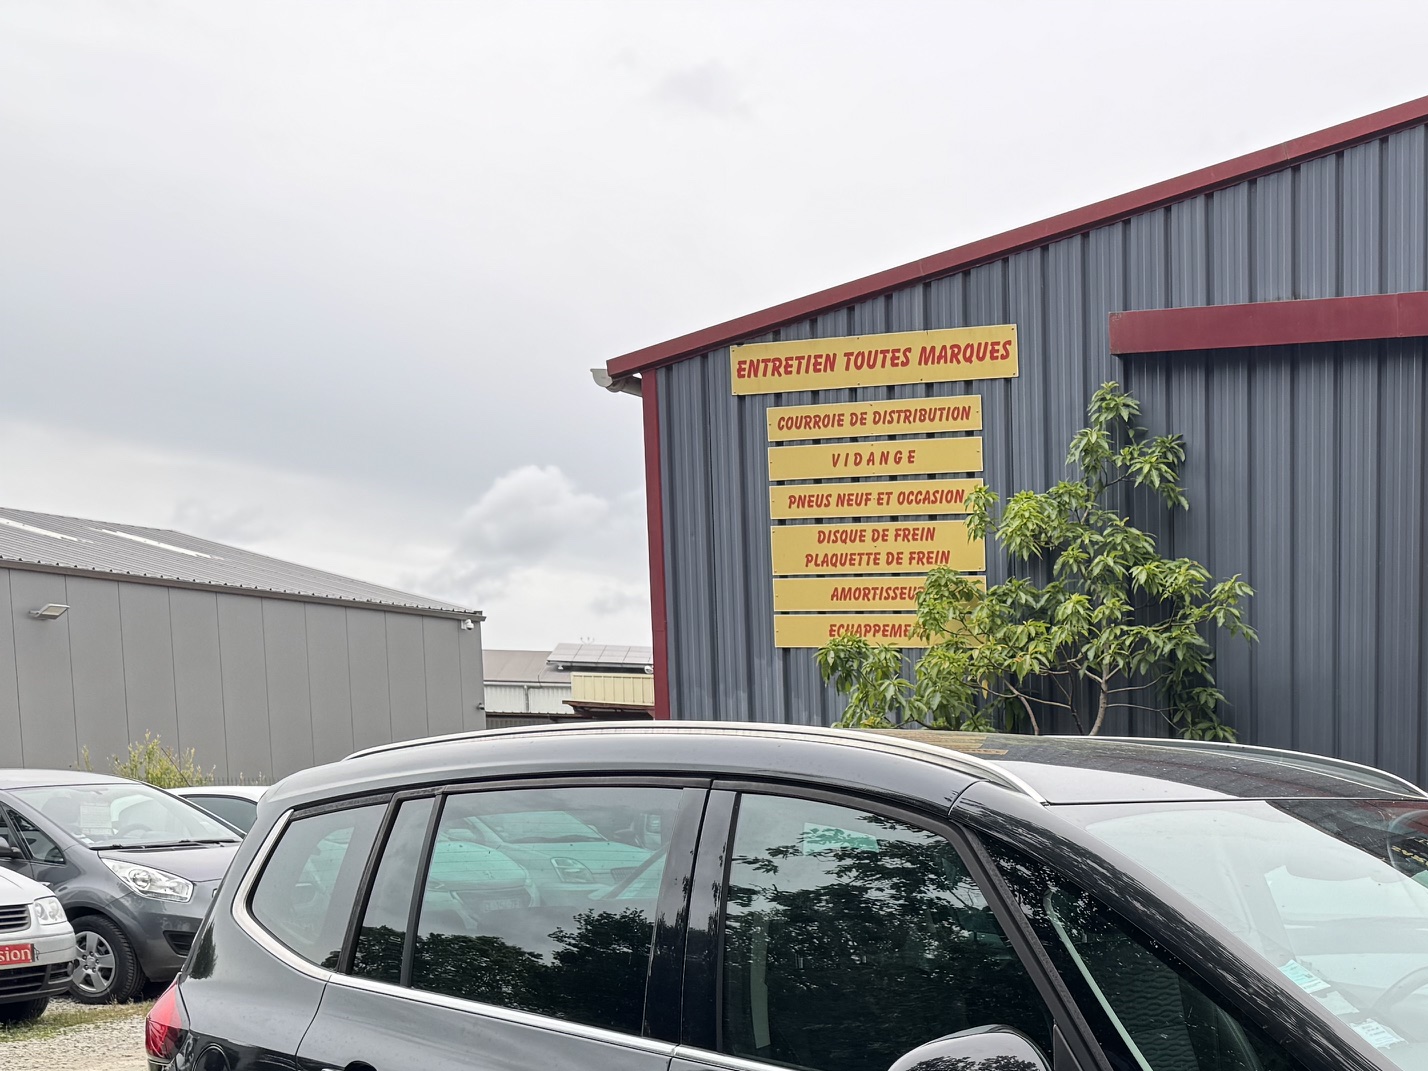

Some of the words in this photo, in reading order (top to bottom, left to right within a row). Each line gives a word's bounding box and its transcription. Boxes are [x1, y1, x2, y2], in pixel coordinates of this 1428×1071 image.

[736, 352, 838, 379] ENTRETIEN
[843, 346, 912, 372] TOUTES
[917, 339, 1012, 366] MARQUES
[777, 412, 845, 431] COURROIE
[850, 410, 868, 427] DE
[872, 405, 972, 425] DISTRIBUTION
[788, 493, 832, 509] PNEUS
[836, 491, 872, 507] NEUF
[876, 490, 893, 506] ET
[897, 488, 965, 505] OCCASION
[817, 528, 866, 545] DISQUE
[871, 527, 889, 542] DE
[893, 526, 936, 542] FREIN
[805, 551, 881, 568] PLAQUETTE
[885, 550, 903, 566] DE
[908, 549, 951, 565] FREIN
